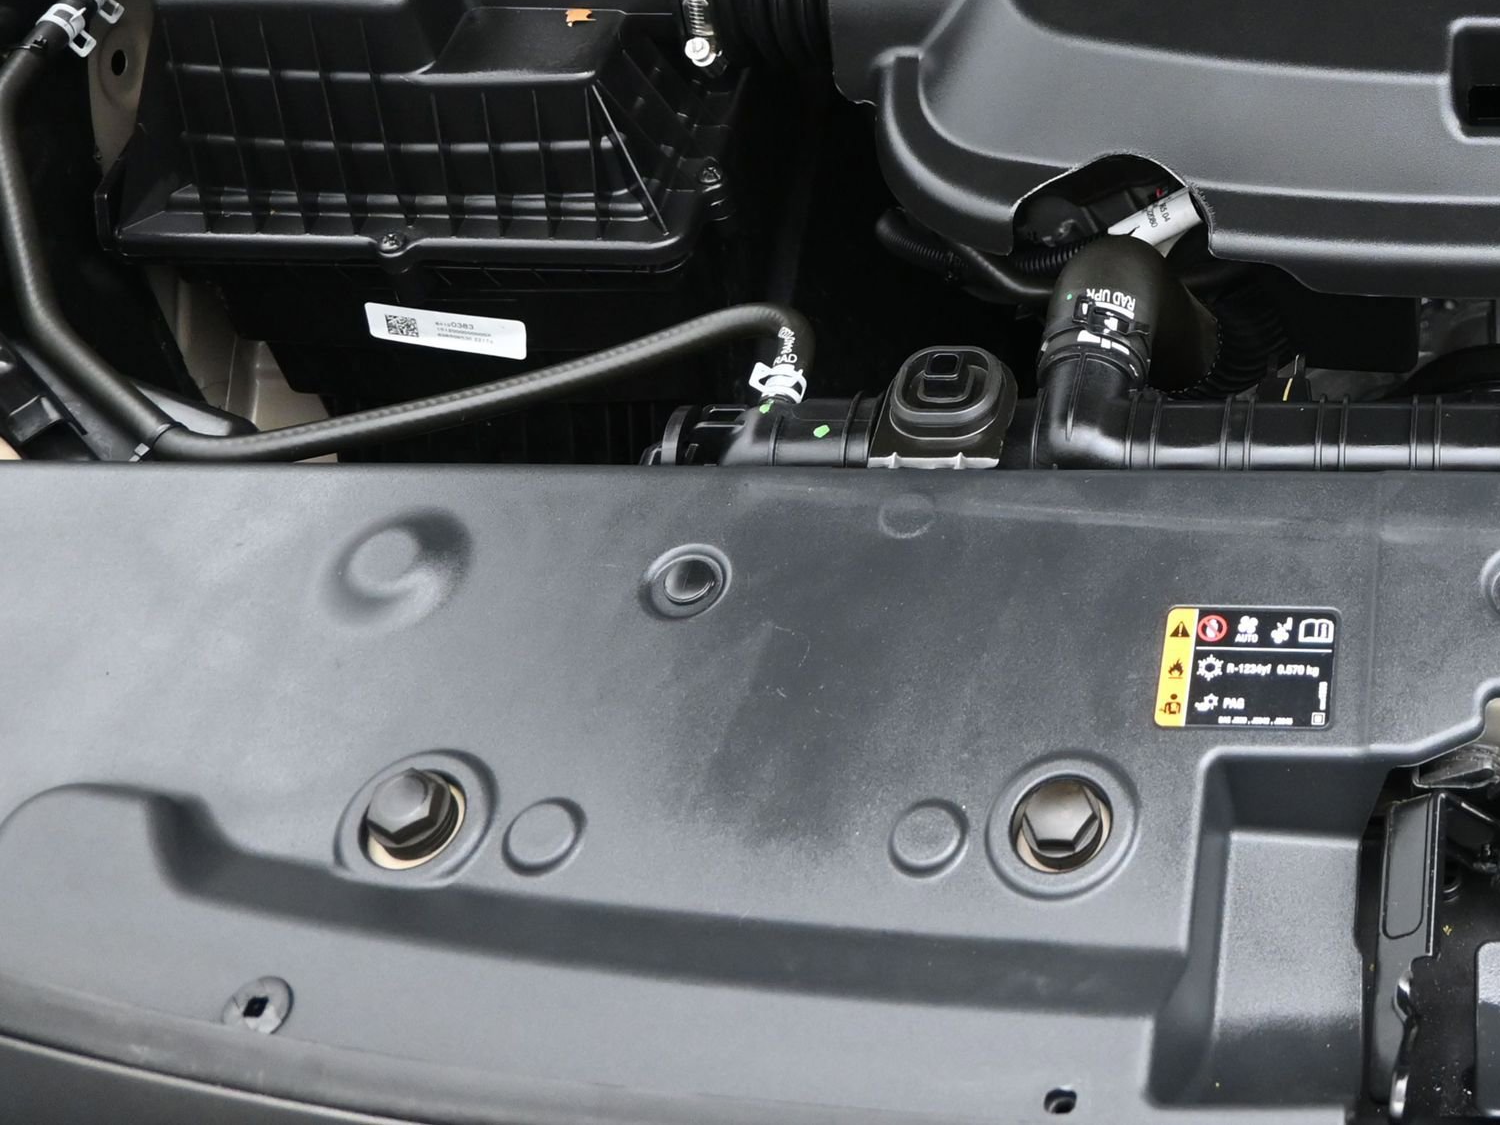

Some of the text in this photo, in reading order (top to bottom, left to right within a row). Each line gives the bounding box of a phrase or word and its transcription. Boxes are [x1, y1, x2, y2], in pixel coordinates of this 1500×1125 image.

[1112, 291, 1137, 311] RAD
[773, 353, 798, 367] RAD
[1234, 633, 1259, 644] AUTO
[1305, 664, 1320, 678] kg
